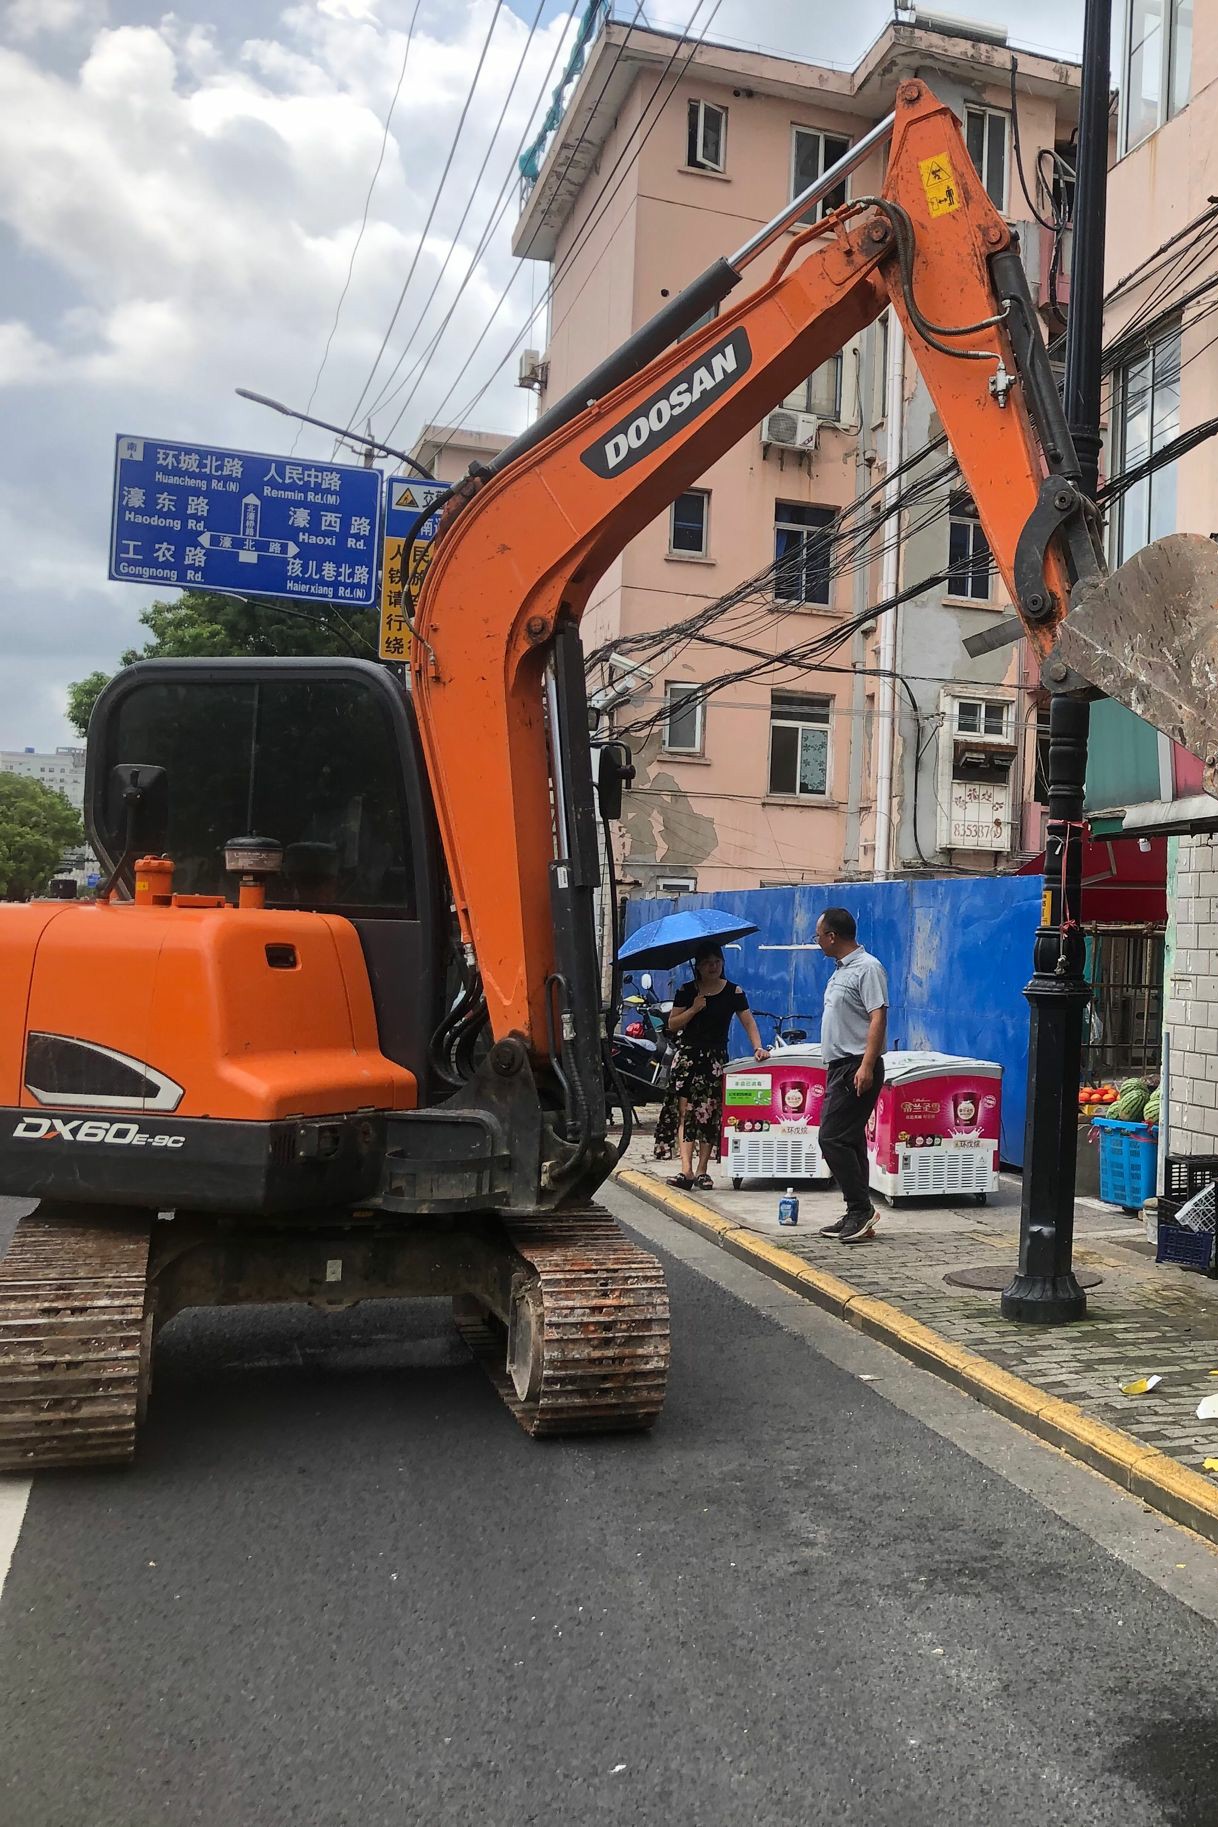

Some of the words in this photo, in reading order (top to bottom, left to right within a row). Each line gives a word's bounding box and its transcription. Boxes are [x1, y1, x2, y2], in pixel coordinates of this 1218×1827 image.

[604, 343, 738, 470] DOOSAN
[156, 448, 244, 479] 环城北路
[155, 471, 208, 491] Huancheng
[211, 479, 240, 493] Rd.(N)
[263, 462, 342, 491] 人民中路
[122, 486, 209, 517] 濠东路
[263, 485, 305, 501] Renmin
[307, 491, 341, 506] Rd.(M)
[125, 511, 182, 530] Haodong
[187, 519, 208, 532] Rd.
[288, 506, 371, 536] 濠西路
[119, 539, 208, 568] 工农路
[219, 535, 282, 554] 濠北路
[299, 532, 336, 546] Haoxi
[347, 537, 367, 550] Rd.
[119, 562, 178, 580] Gongnong
[186, 570, 205, 582] Rd.
[287, 557, 370, 585] 孩儿巷北路
[286, 580, 334, 597] Haierxiang
[338, 586, 366, 599] Rd.(N)
